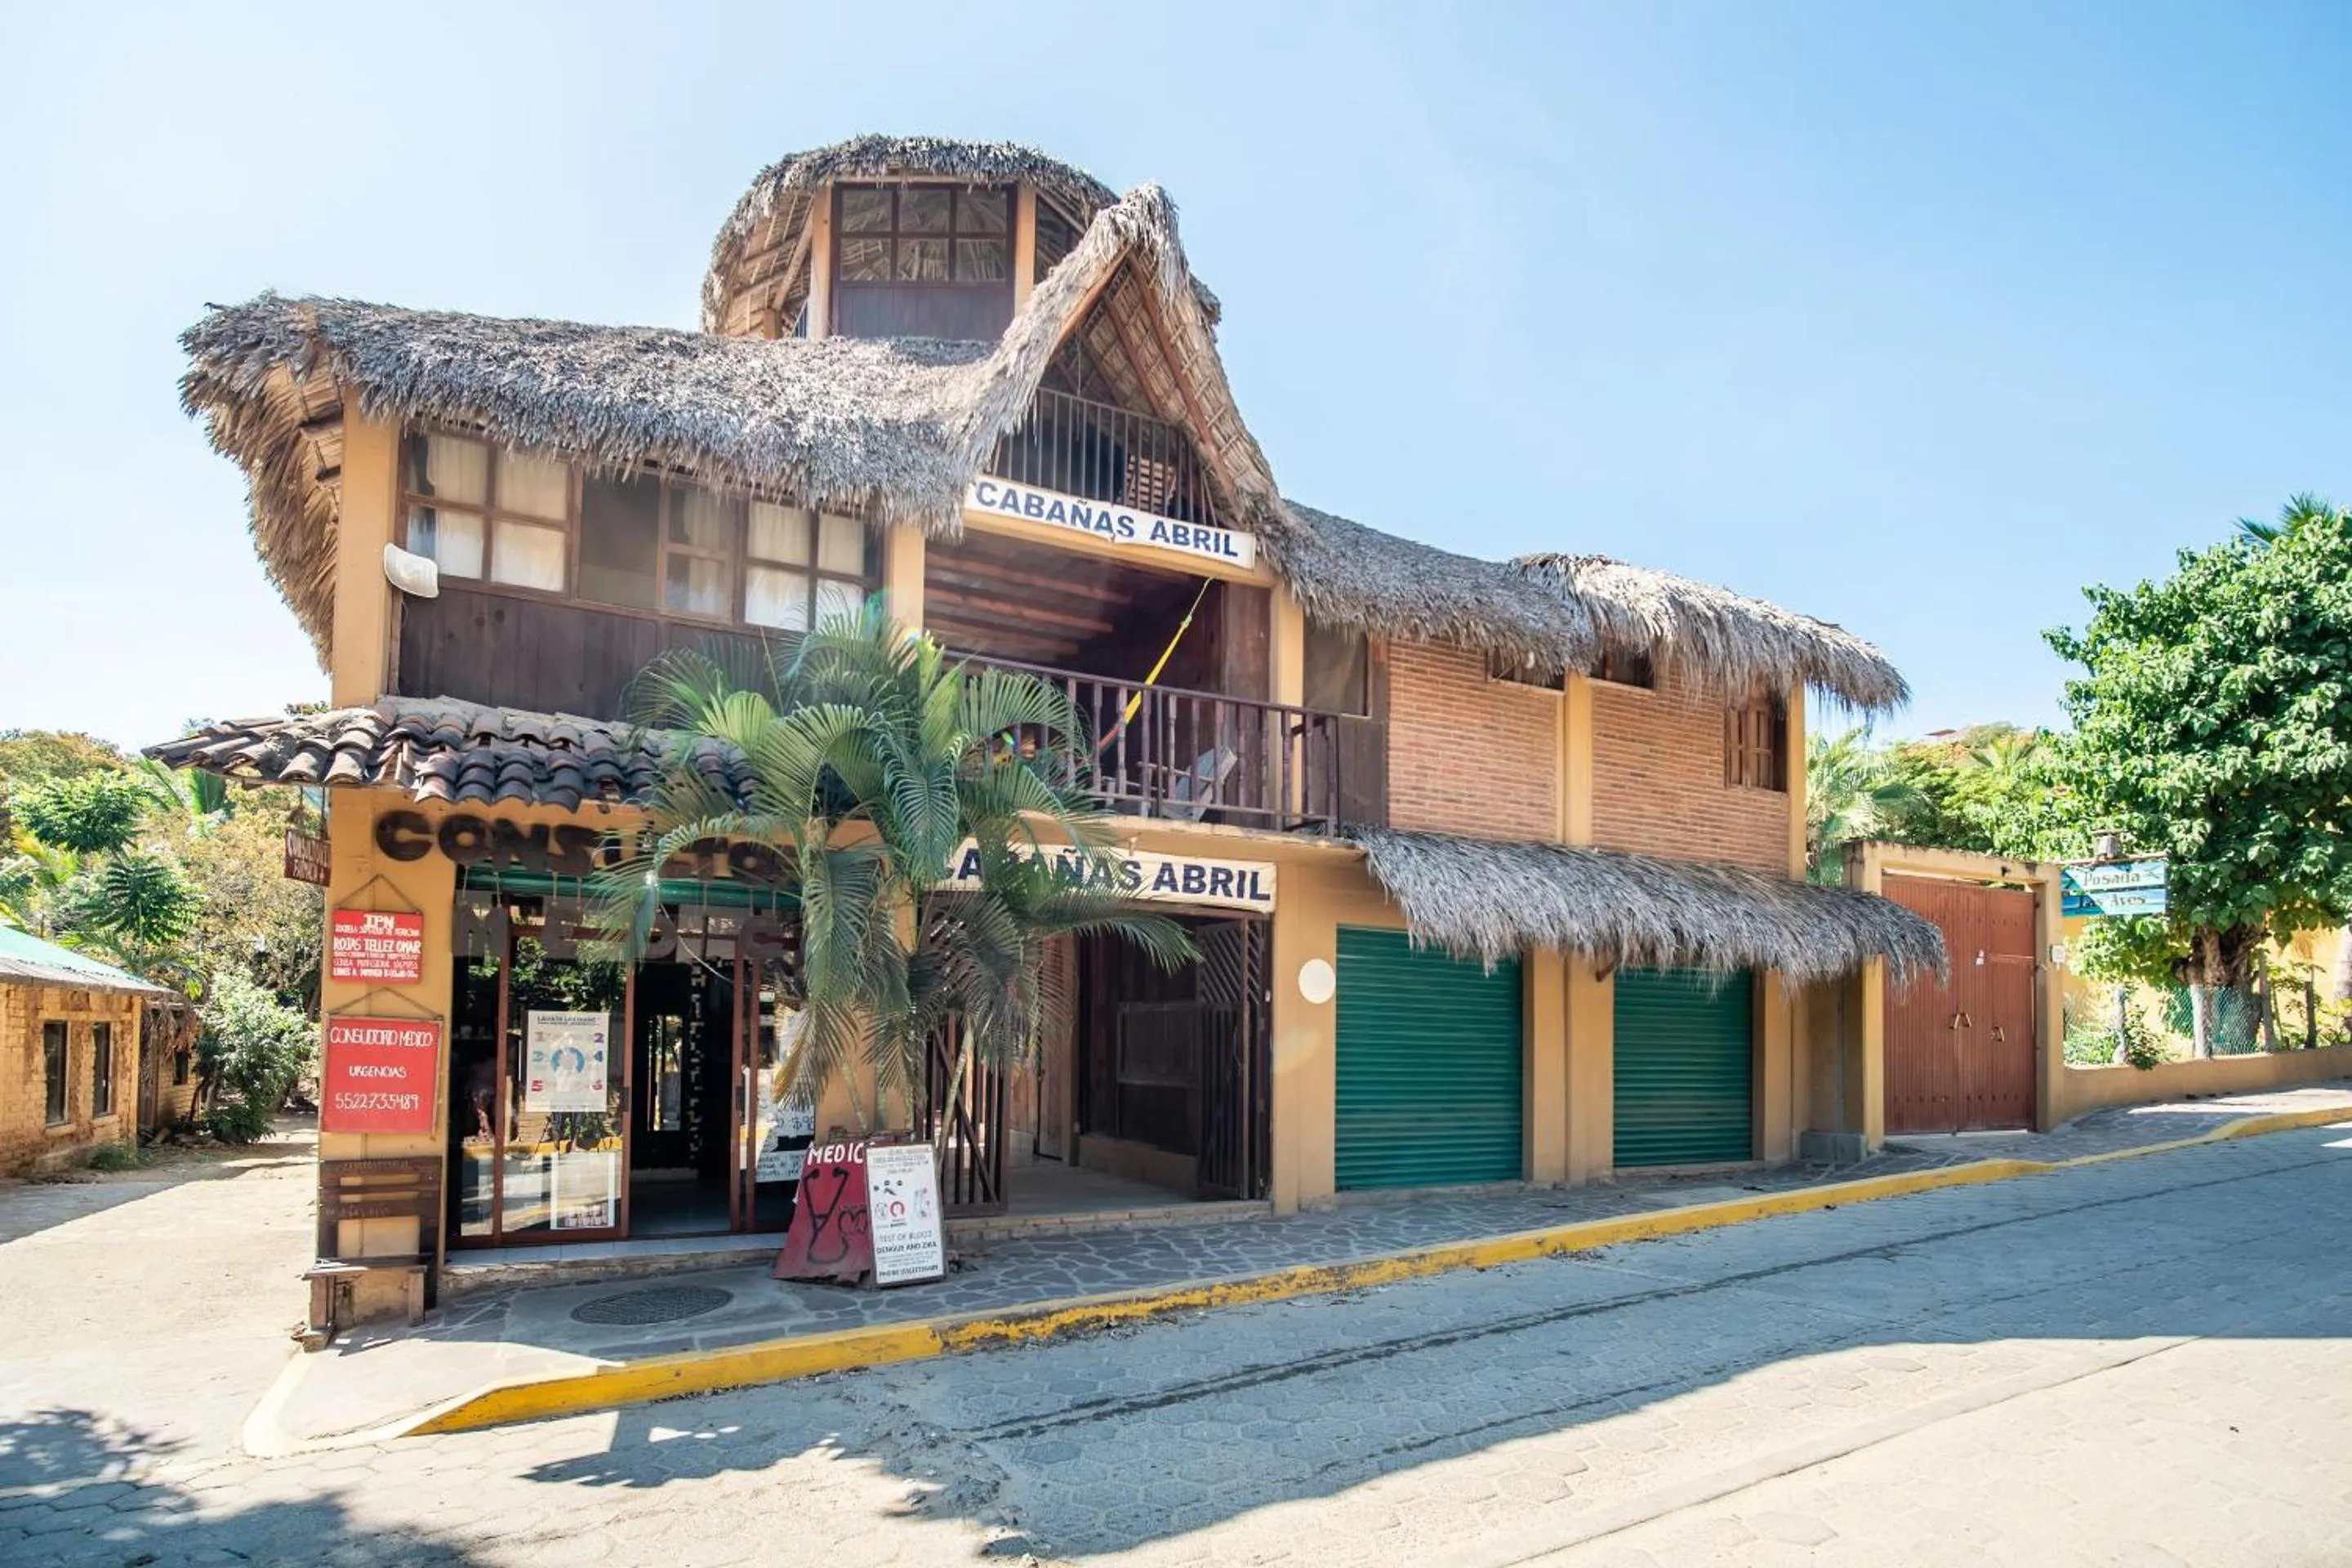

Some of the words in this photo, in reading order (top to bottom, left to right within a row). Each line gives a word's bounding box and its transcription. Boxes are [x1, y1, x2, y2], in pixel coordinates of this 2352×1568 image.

[975, 482, 1135, 538] CABAÑAS
[1150, 520, 1239, 558] ABRIL
[1152, 861, 1272, 902] ABRIL
[349, 1066, 407, 1078] URGENCIAS
[807, 1143, 876, 1166] MEDIC
